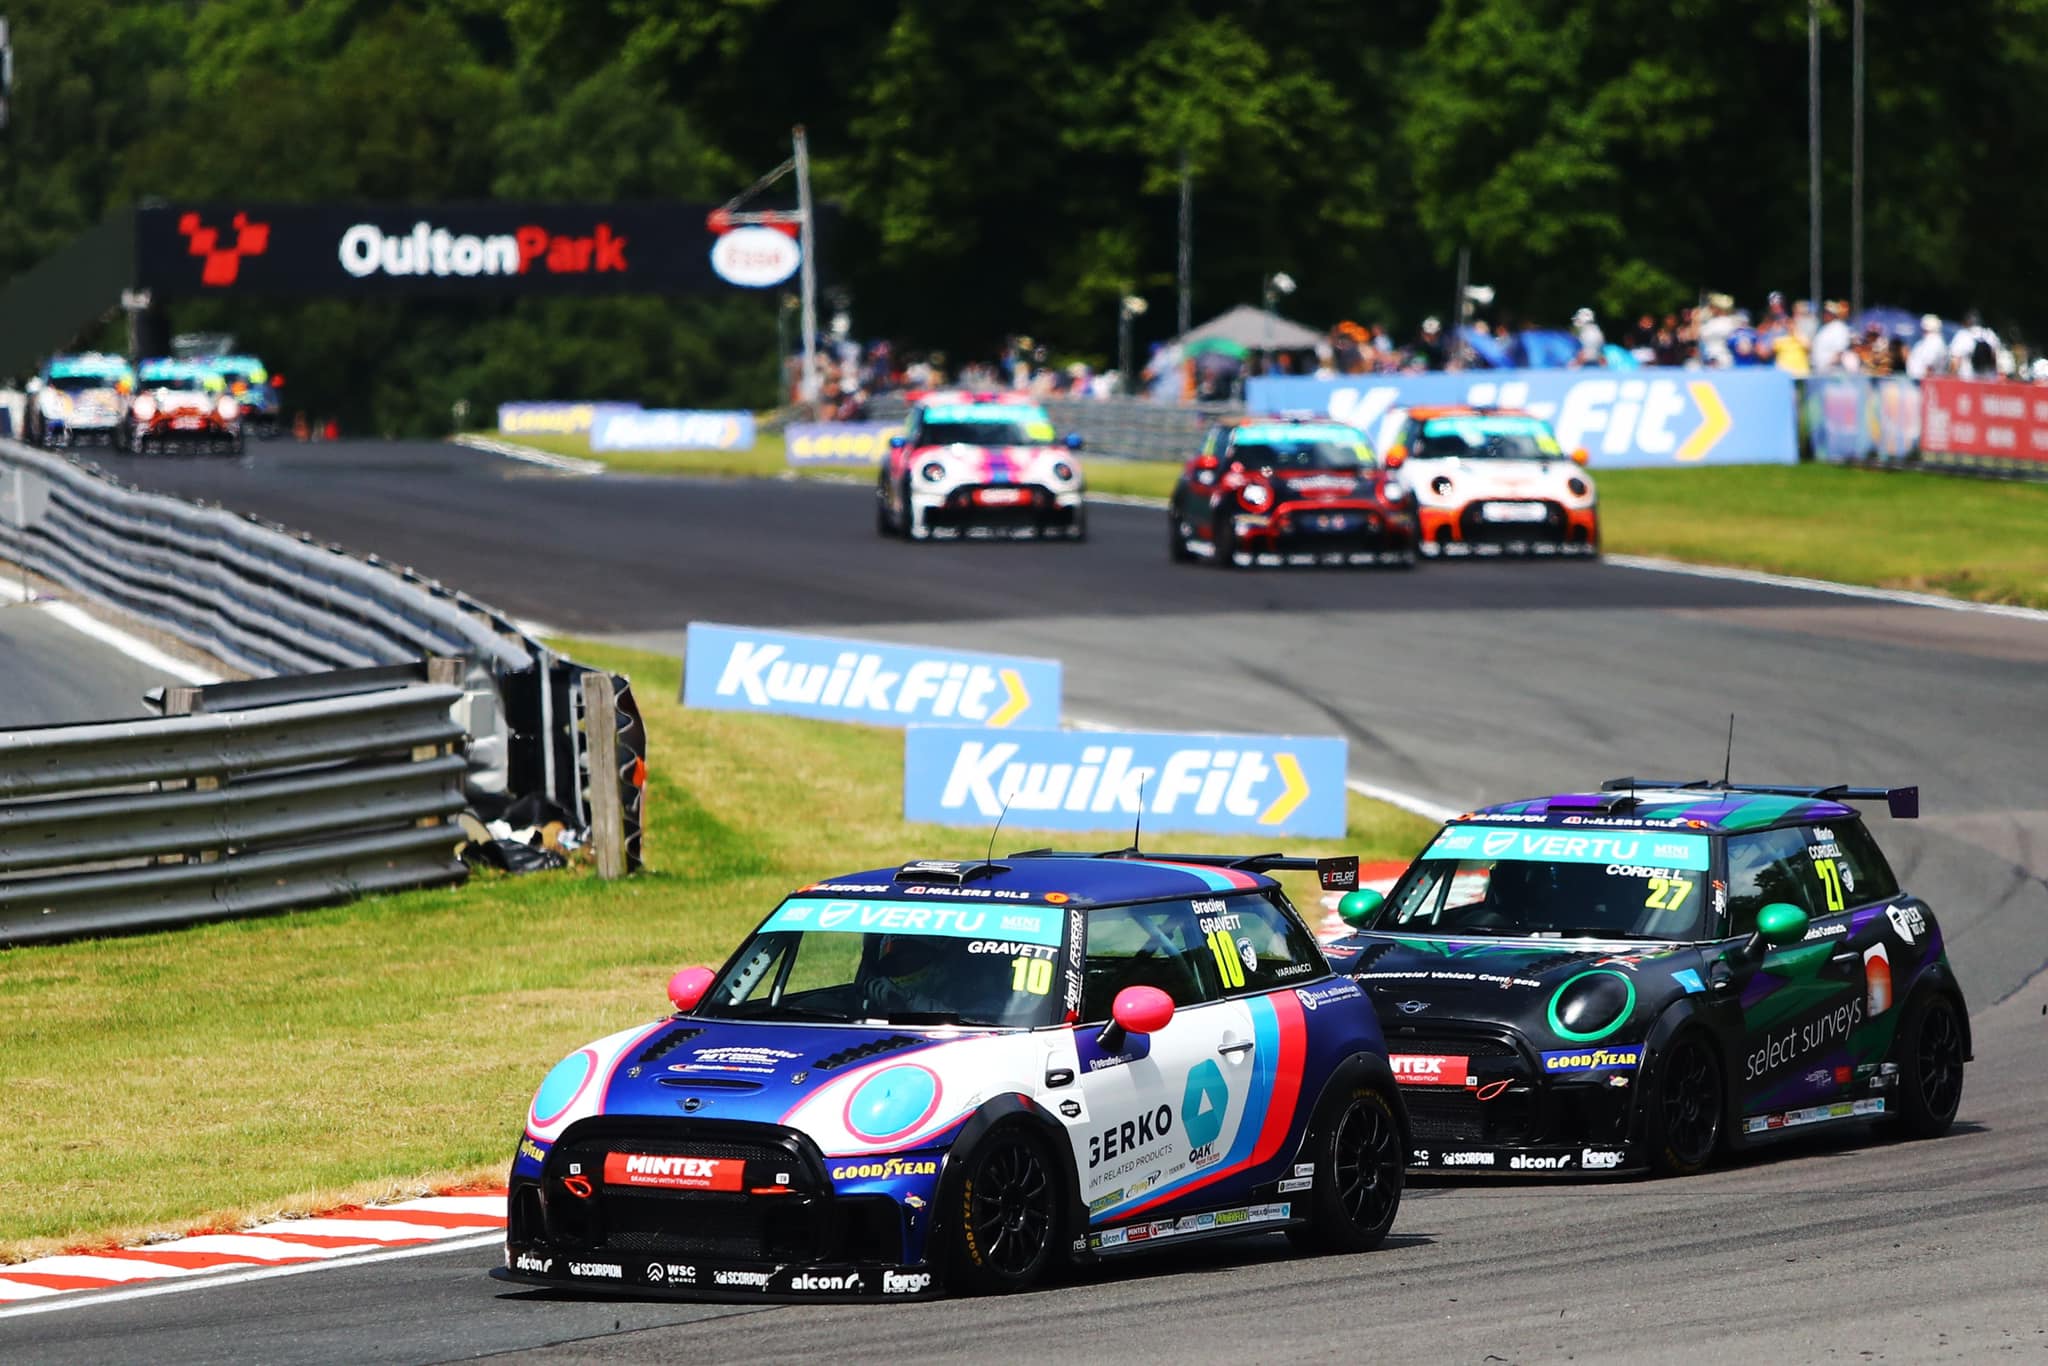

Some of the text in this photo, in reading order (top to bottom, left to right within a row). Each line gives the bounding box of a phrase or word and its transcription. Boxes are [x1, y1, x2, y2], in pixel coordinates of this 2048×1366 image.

[1523, 834, 1639, 860] VERTU
[1606, 864, 1684, 881] CORDELL
[926, 887, 1030, 899] MILLERS OILS
[1645, 877, 1693, 912] 27
[1192, 898, 1227, 914] Bradley
[860, 906, 985, 932] VERTU
[1200, 914, 1242, 933] GRAVETT
[967, 940, 1058, 960] GRAVETT
[1206, 930, 1246, 989] 10
[1011, 956, 1053, 996] 10
[1745, 997, 1862, 1081] select surveys
[1389, 1057, 1446, 1074] NTEX
[1546, 1050, 1637, 1069] GOODYEAR
[1089, 1103, 1173, 1169] GERKO
[625, 1154, 717, 1178] MINTEX
[832, 1157, 937, 1180] GOODYEAR
[1103, 1162, 1135, 1182] RELATED
[1135, 1143, 1173, 1167] PRODUCTS
[1509, 1154, 1556, 1169] alcon
[516, 1253, 543, 1272] alcon
[580, 1262, 623, 1278] SCORPION
[667, 1264, 697, 1277] WSC
[791, 1273, 844, 1290] alcon
